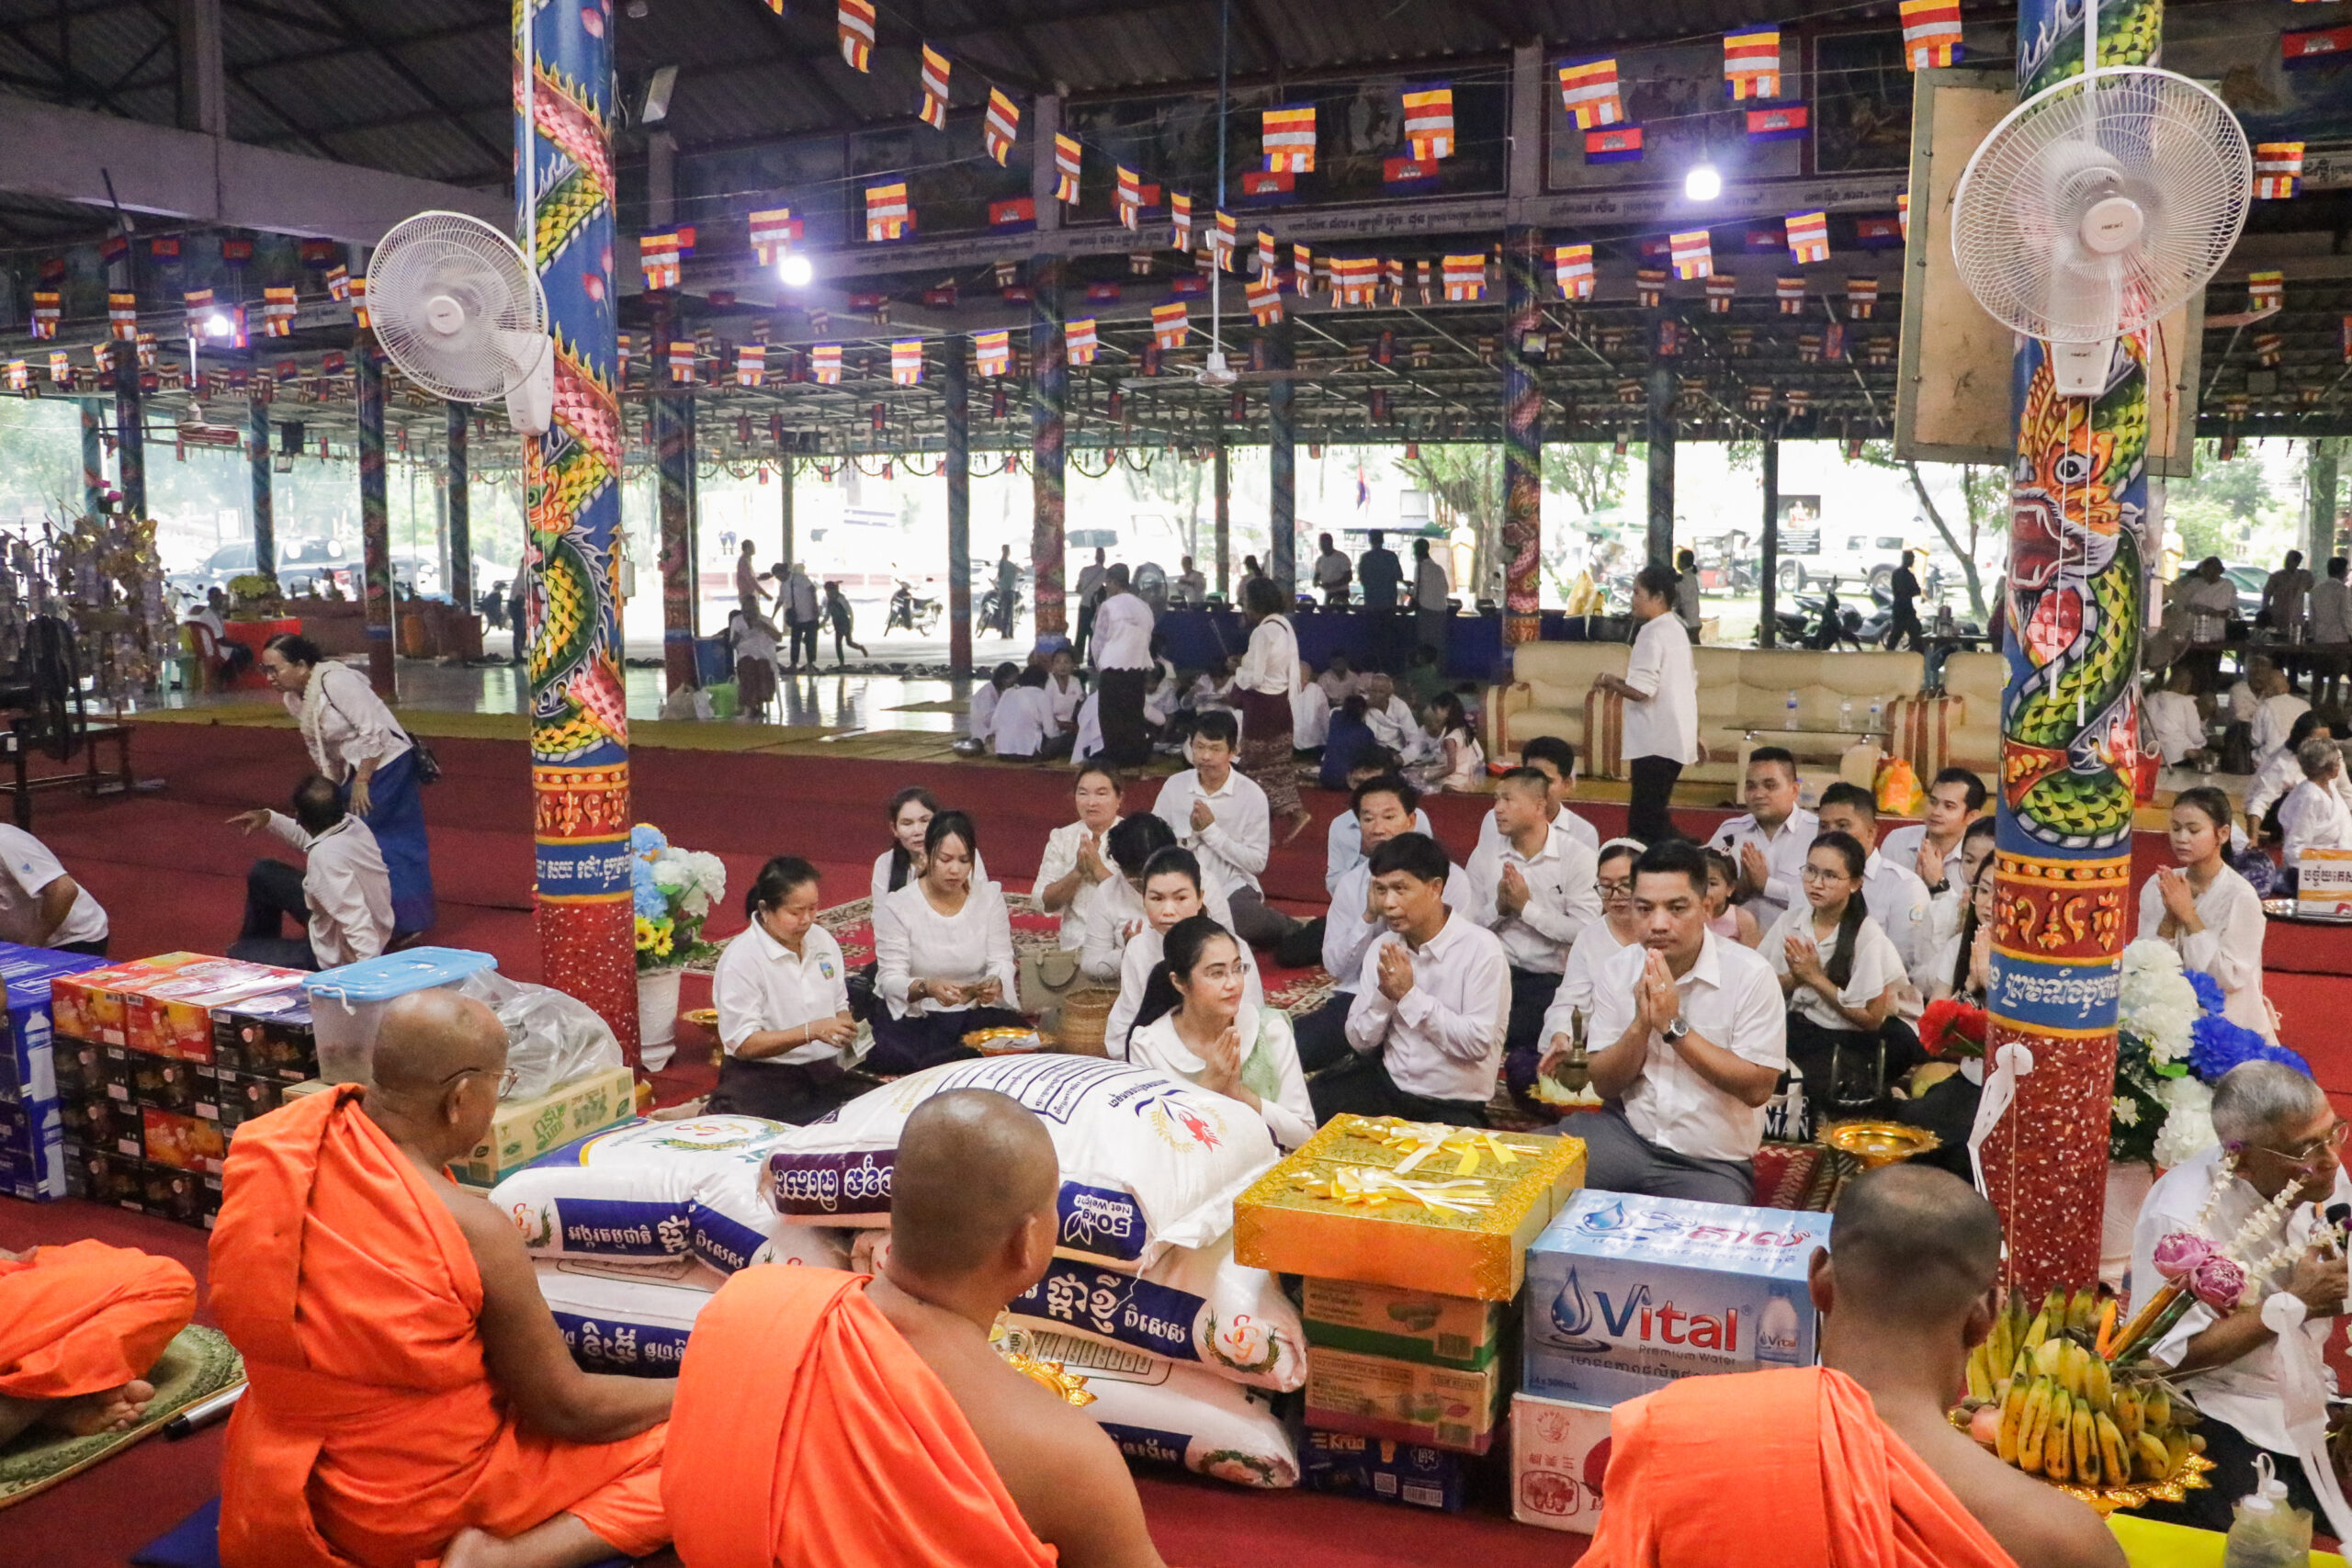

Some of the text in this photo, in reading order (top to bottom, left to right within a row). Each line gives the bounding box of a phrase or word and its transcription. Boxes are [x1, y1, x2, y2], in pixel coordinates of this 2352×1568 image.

[1076, 1196, 1131, 1215] Net Weight
[1593, 1283, 1738, 1352] Vital
[1638, 1343, 1737, 1367] Premium Water
